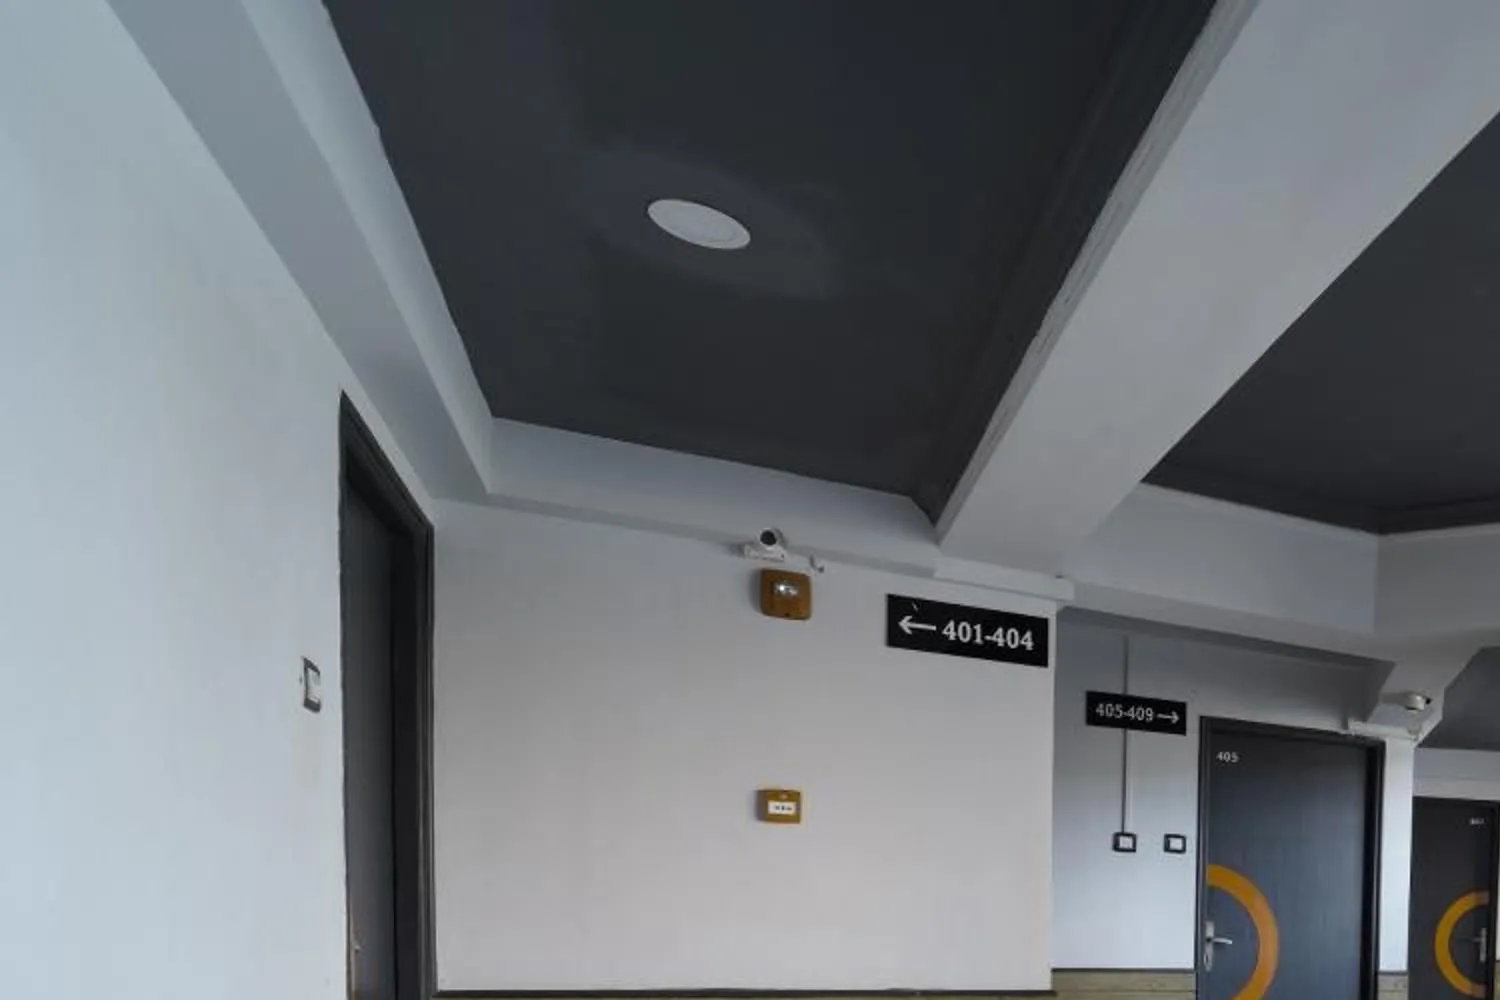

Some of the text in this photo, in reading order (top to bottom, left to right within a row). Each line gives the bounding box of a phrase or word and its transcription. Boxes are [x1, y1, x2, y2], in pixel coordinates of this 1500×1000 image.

[941, 619, 1034, 650] 401-404
[1095, 703, 1154, 722] 405-409
[1215, 751, 1238, 763] 405
